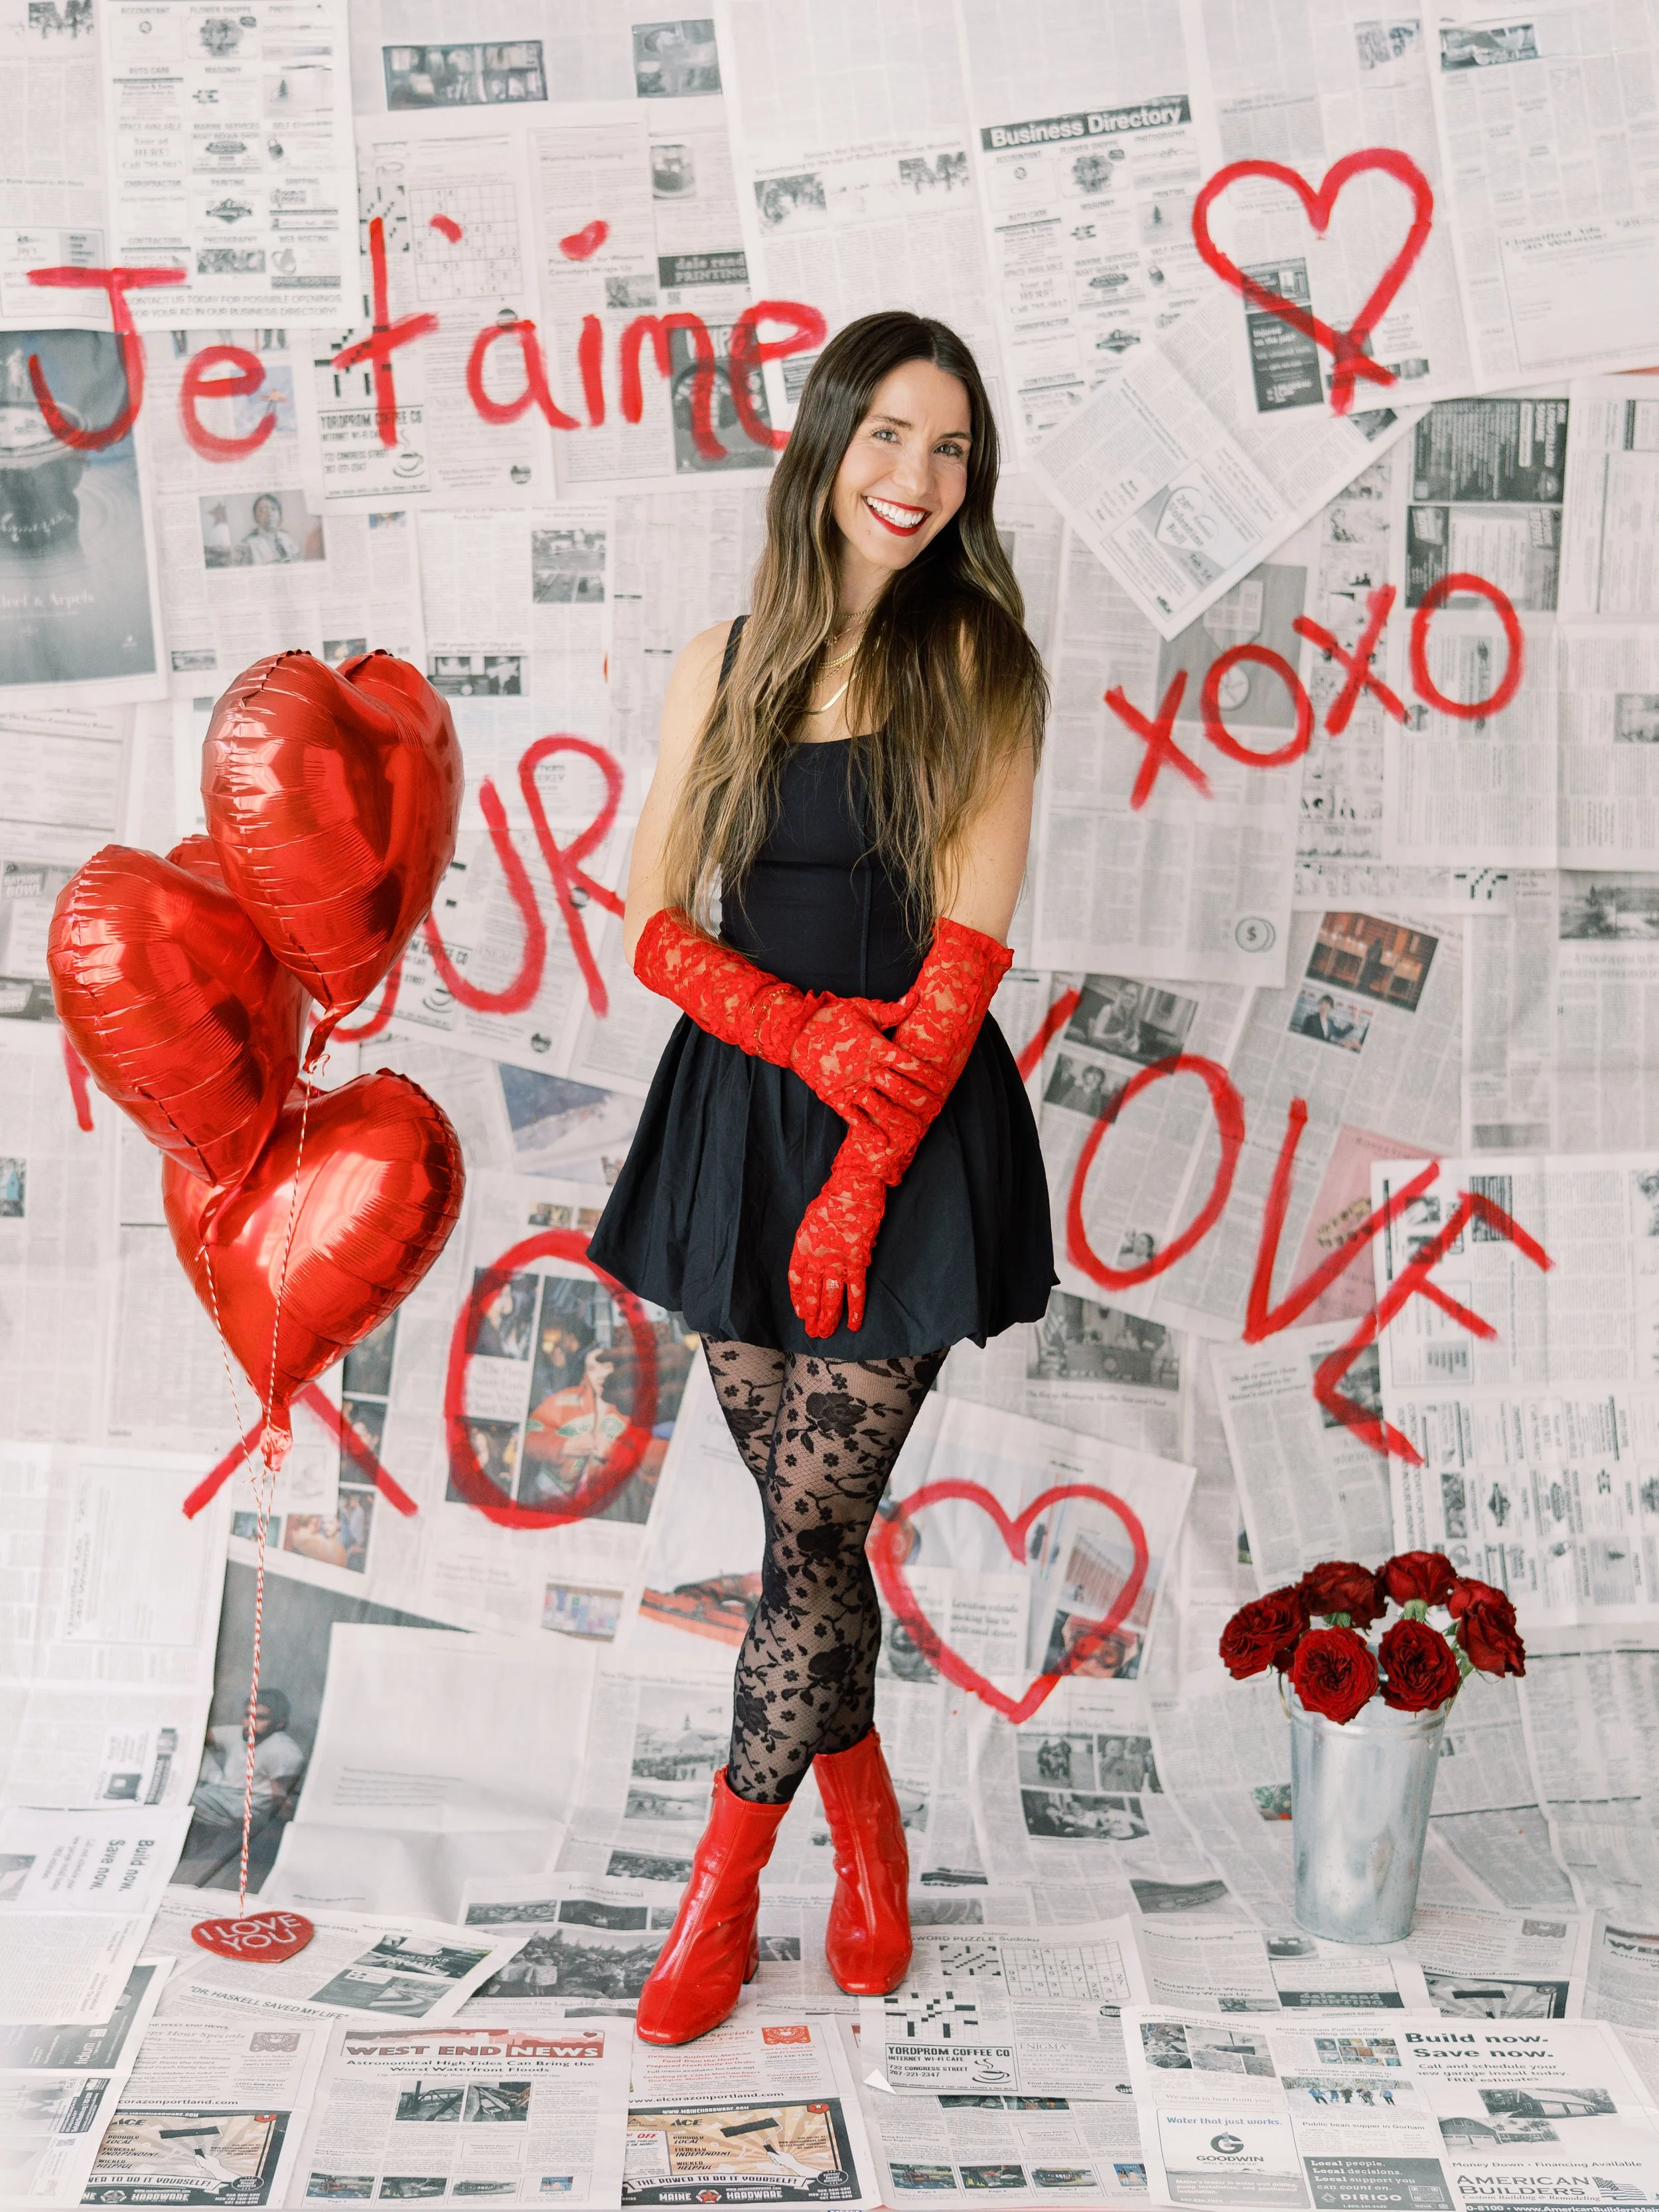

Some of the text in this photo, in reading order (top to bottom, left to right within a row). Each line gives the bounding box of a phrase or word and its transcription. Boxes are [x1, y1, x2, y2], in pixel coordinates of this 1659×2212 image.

[990, 105, 1182, 148] Business Directory
[27, 265, 277, 462] Je
[90, 1839, 126, 1890] Save now.
[118, 1840, 155, 1892] Build now.
[199, 1914, 302, 1941] I LOVE
[220, 1930, 297, 1951] YOU
[212, 1989, 260, 2005] HASKELL
[263, 2001, 300, 2012] SAVED
[301, 2007, 319, 2016] MY
[1405, 2033, 1475, 2043] Build
[346, 2046, 599, 2057] WEST END NEWS
[888, 2047, 949, 2055] YORDPROM
[1413, 2049, 1480, 2057] Save
[156, 2178, 211, 2187] YOURSELF!
[1457, 2176, 1589, 2185] AMERICAN
[726, 2190, 782, 2199] HARDWARE
[1460, 2185, 1585, 2195] BUILDERS
